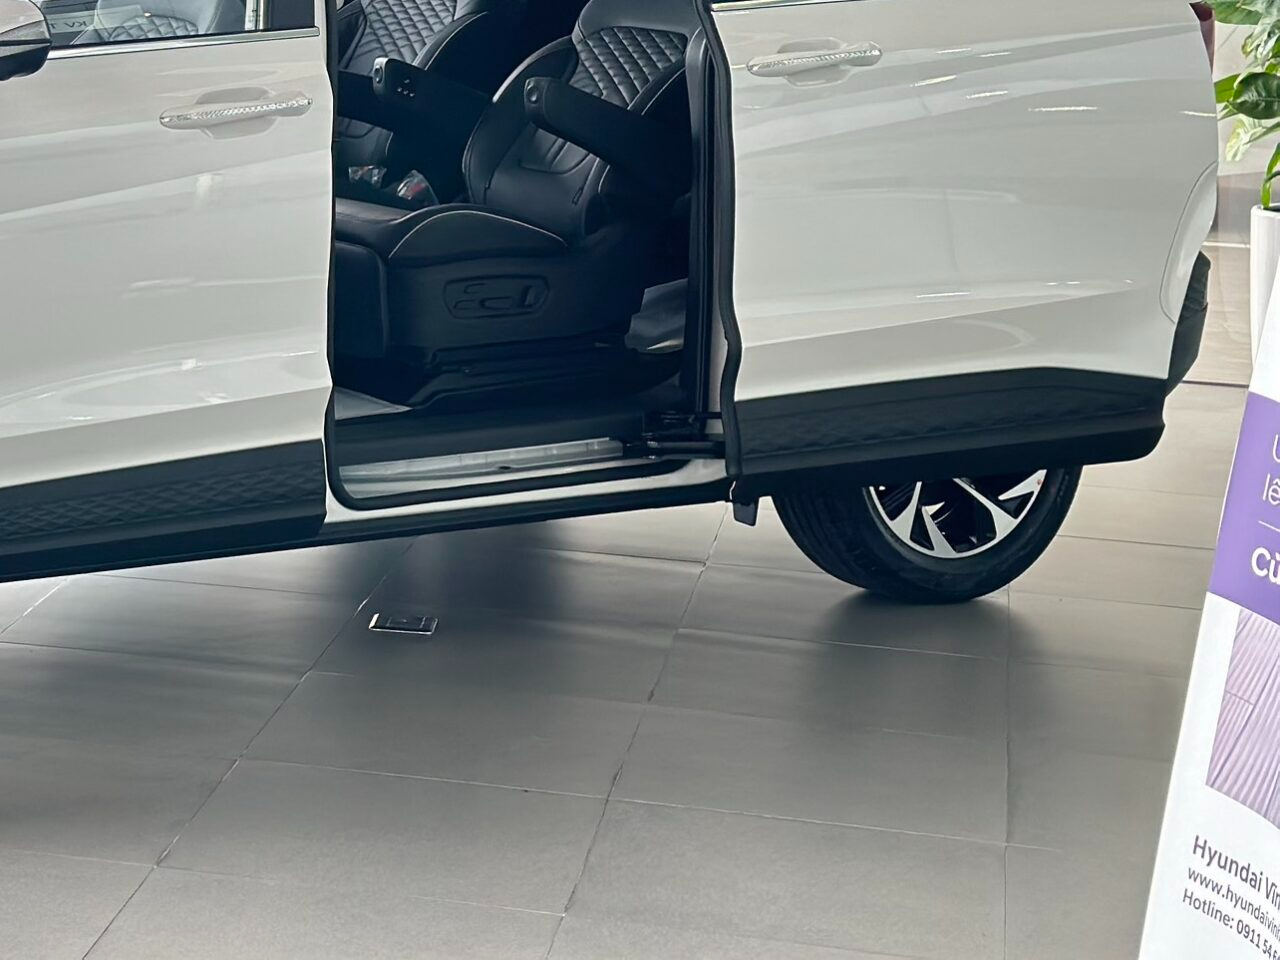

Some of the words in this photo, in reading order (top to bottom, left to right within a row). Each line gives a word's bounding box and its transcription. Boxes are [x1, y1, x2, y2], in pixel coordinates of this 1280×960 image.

[1193, 835, 1263, 893] Hyundai
[1183, 888, 1235, 929] Hotline:
[1236, 919, 1261, 949] 0911
